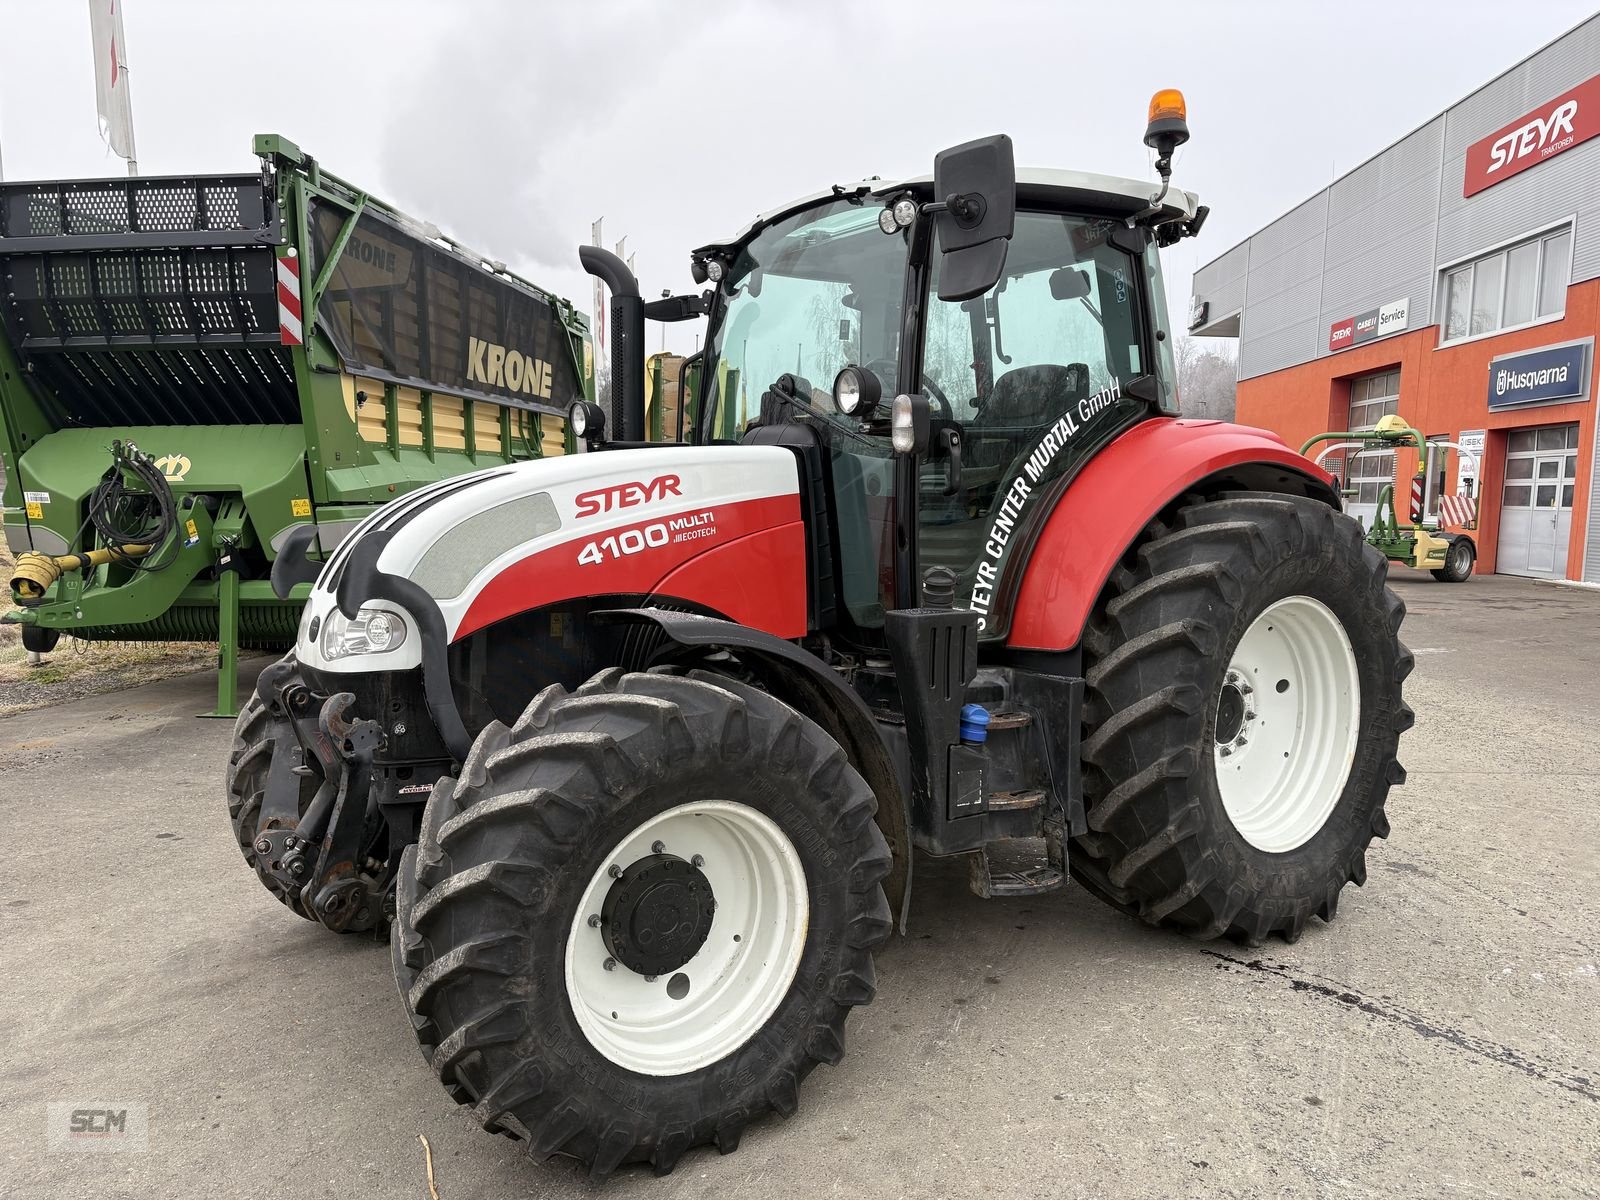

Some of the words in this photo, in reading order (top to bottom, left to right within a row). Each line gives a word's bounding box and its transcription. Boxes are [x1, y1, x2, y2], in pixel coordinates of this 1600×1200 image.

[1486, 100, 1578, 174] STEYR
[1541, 135, 1574, 157] TRAKTOREN
[344, 235, 396, 273] RONE
[1332, 327, 1352, 342] STEYR
[1380, 308, 1405, 325] Service
[466, 336, 552, 399] KRONE
[1506, 366, 1568, 390] Husqvarna
[985, 476, 1032, 559] CENTER
[1023, 411, 1079, 483] MURTAL
[1078, 377, 1121, 423] GmbH
[575, 474, 683, 519] STEYR
[577, 523, 670, 566] 4100
[669, 512, 714, 531] MULTI
[683, 527, 716, 543] ECOTECH
